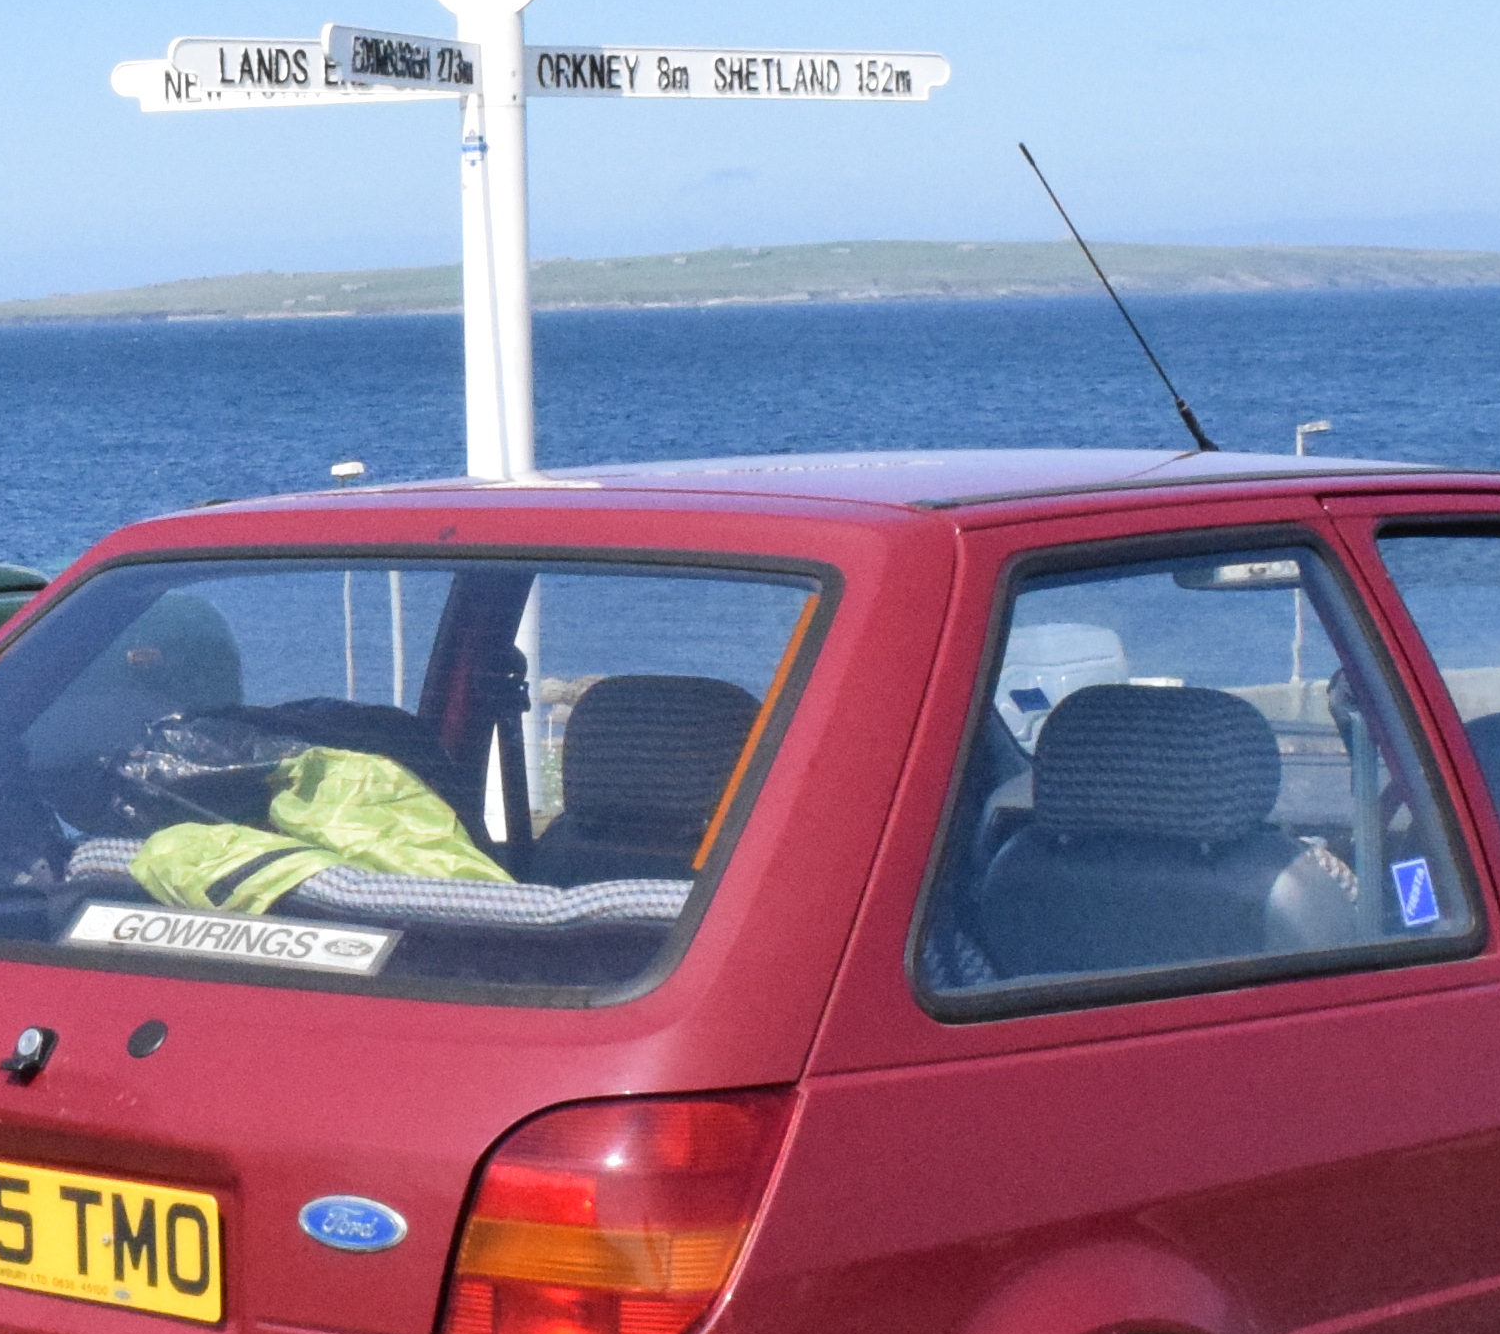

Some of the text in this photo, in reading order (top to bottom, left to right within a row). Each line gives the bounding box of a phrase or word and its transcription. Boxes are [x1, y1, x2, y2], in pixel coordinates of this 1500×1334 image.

[219, 47, 308, 87] LANDS
[536, 53, 911, 94] ORKNEY 8m SHETLAND 152m
[112, 913, 319, 960] GOWRINGS
[60, 1185, 210, 1296] TMO
[322, 1208, 378, 1238] Ford
